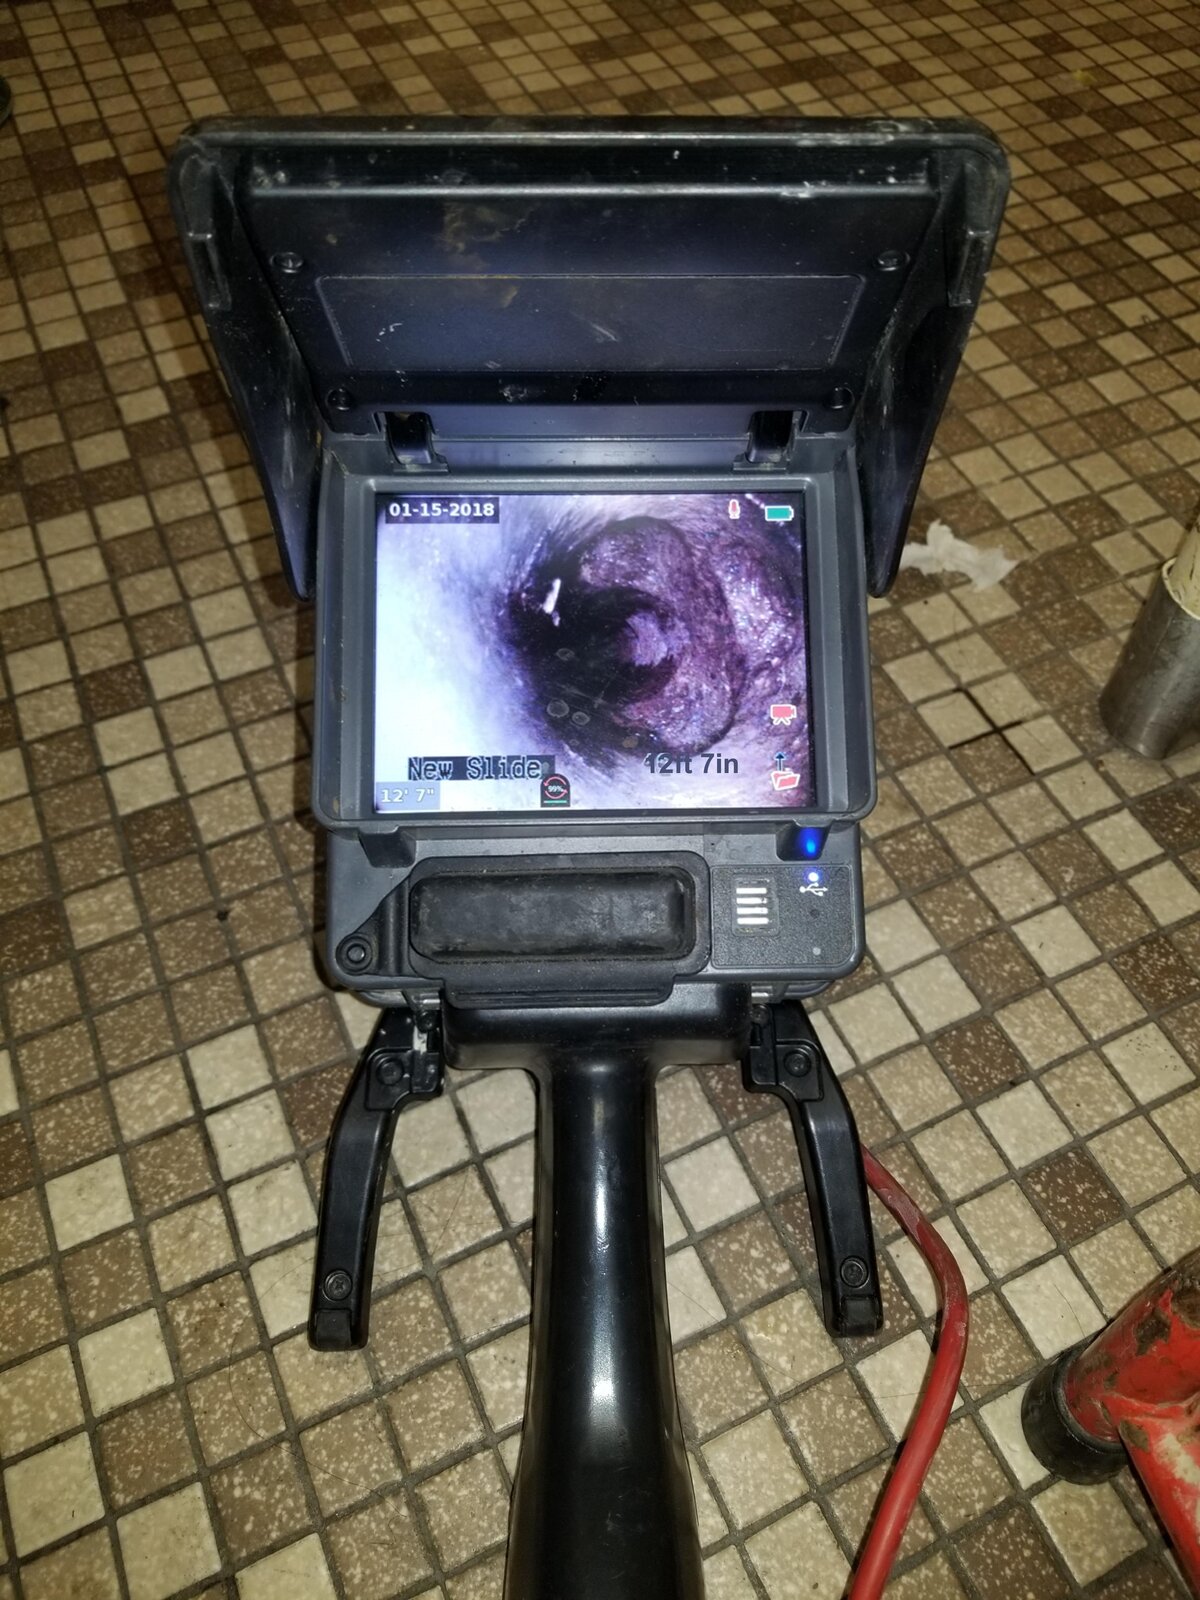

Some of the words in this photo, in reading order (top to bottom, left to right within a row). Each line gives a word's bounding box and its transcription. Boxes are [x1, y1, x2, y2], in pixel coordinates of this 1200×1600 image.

[389, 503, 495, 516] 01-15-2018
[408, 757, 453, 780] New
[466, 755, 542, 780] Slide
[381, 788, 410, 803] 12'
